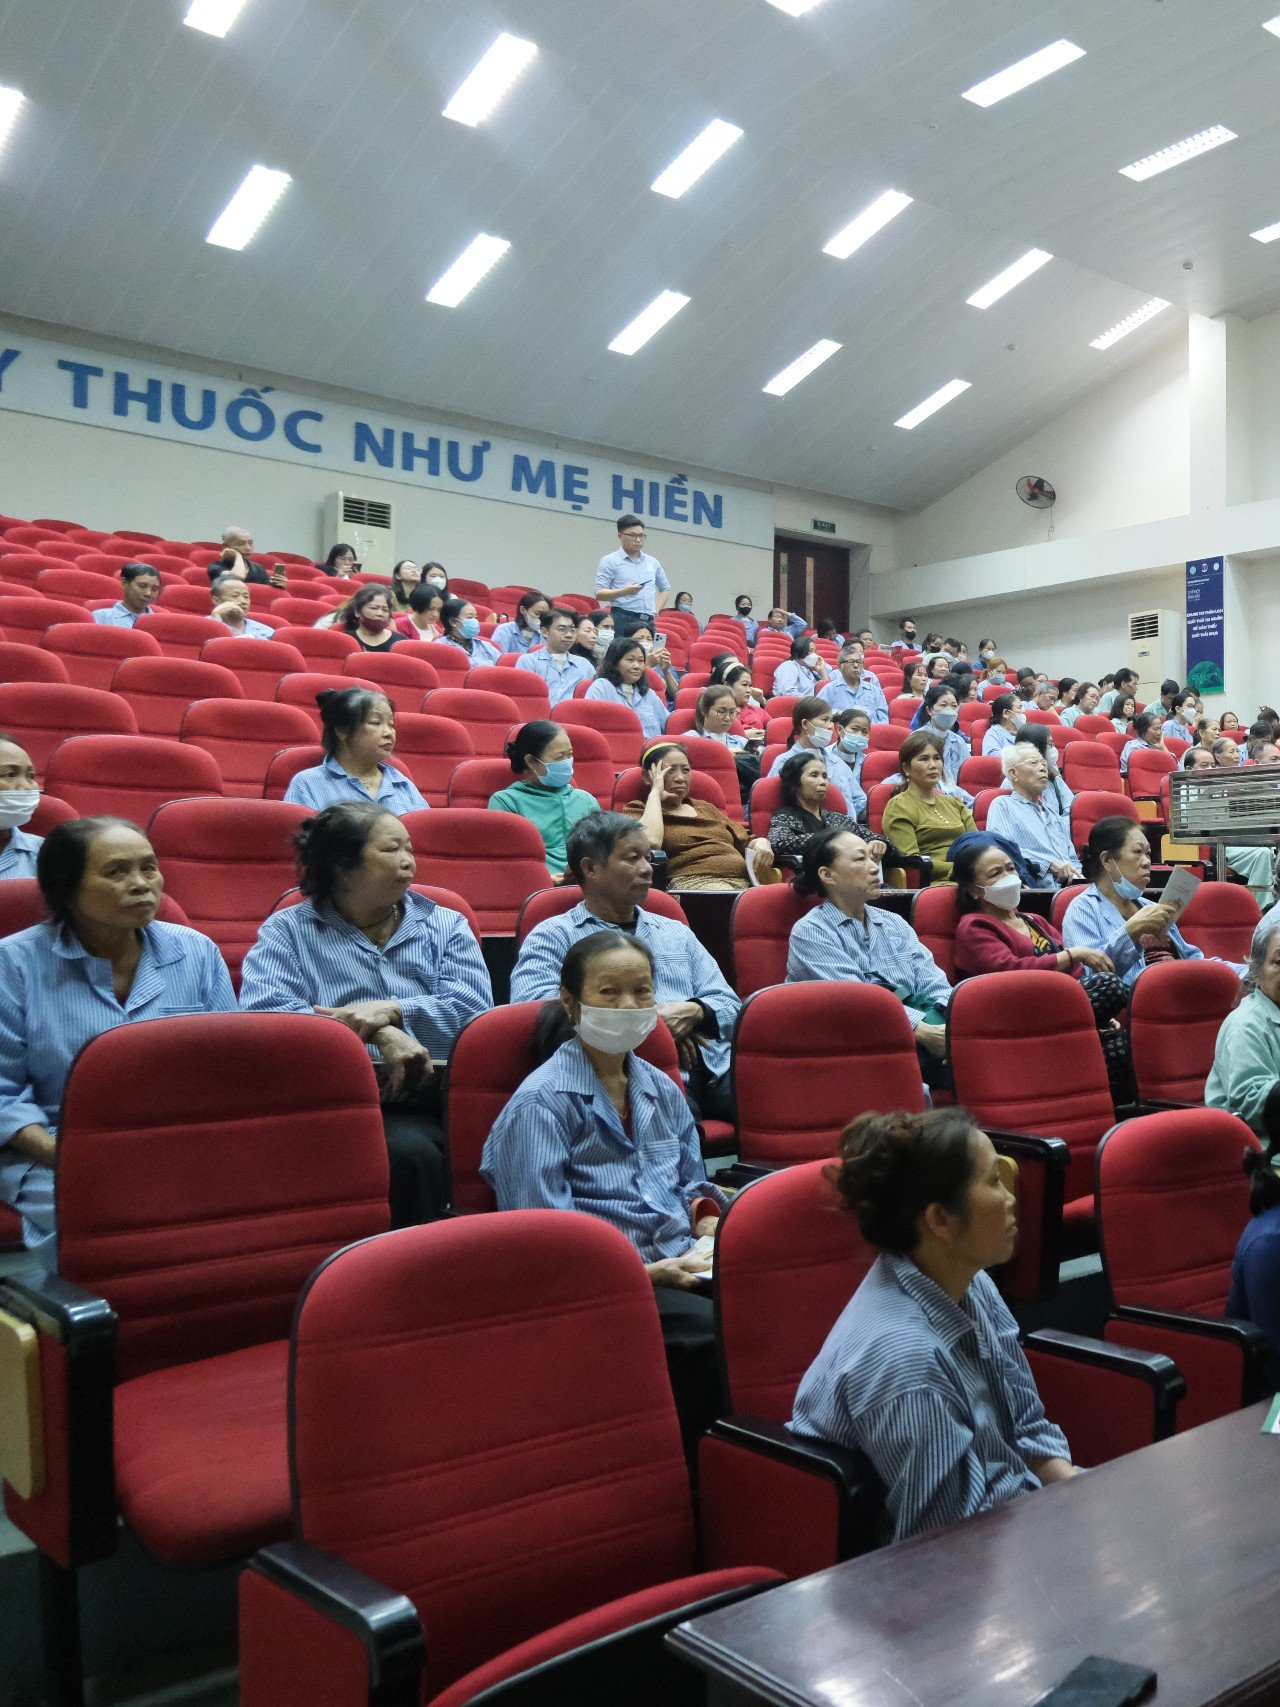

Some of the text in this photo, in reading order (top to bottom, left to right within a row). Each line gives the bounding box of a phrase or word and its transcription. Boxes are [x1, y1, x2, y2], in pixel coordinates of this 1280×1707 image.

[57, 359, 325, 454] THUỐC
[353, 420, 492, 484] NHƯ
[511, 453, 591, 511] MẸ
[611, 473, 724, 529] HIỀN
